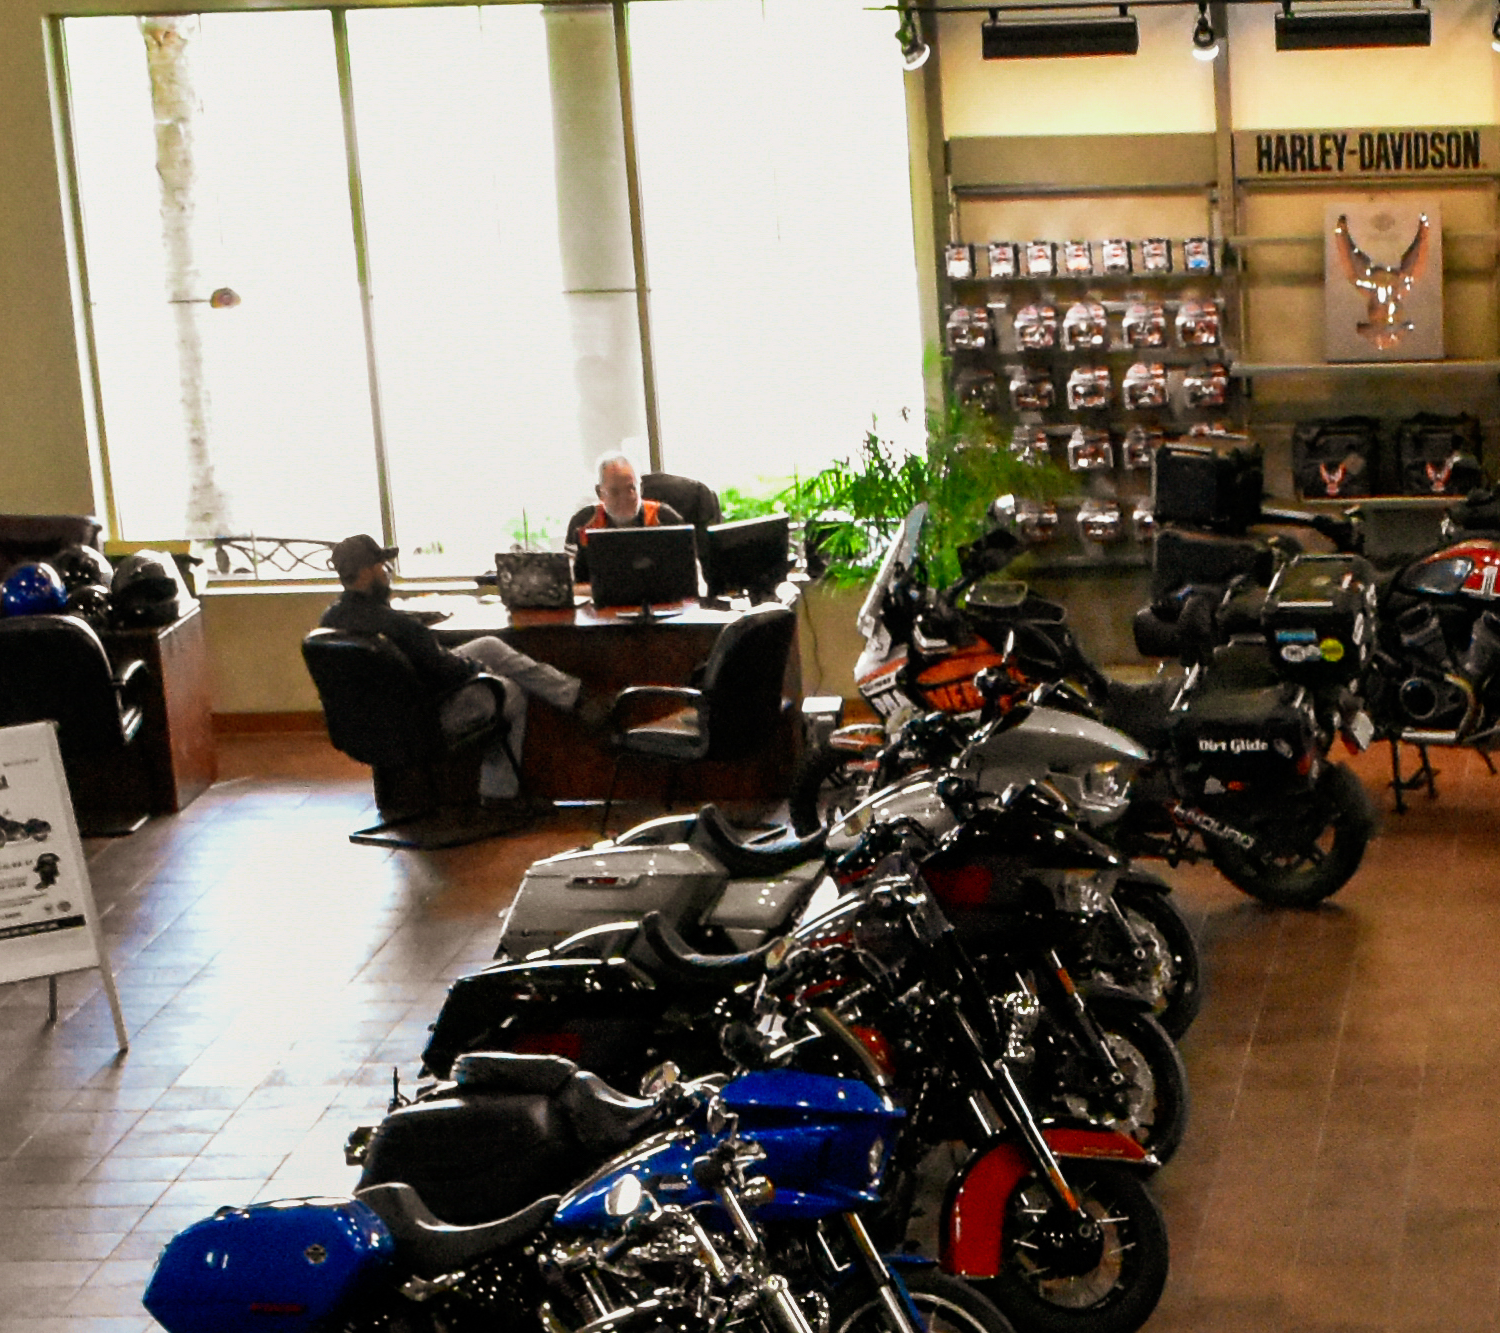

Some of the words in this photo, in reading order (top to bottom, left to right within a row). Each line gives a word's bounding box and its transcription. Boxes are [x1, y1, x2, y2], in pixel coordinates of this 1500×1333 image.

[1256, 131, 1483, 172] HARLEY-DAVIDSON
[1199, 738, 1228, 751] Dirt
[1230, 738, 1269, 754] Glide
